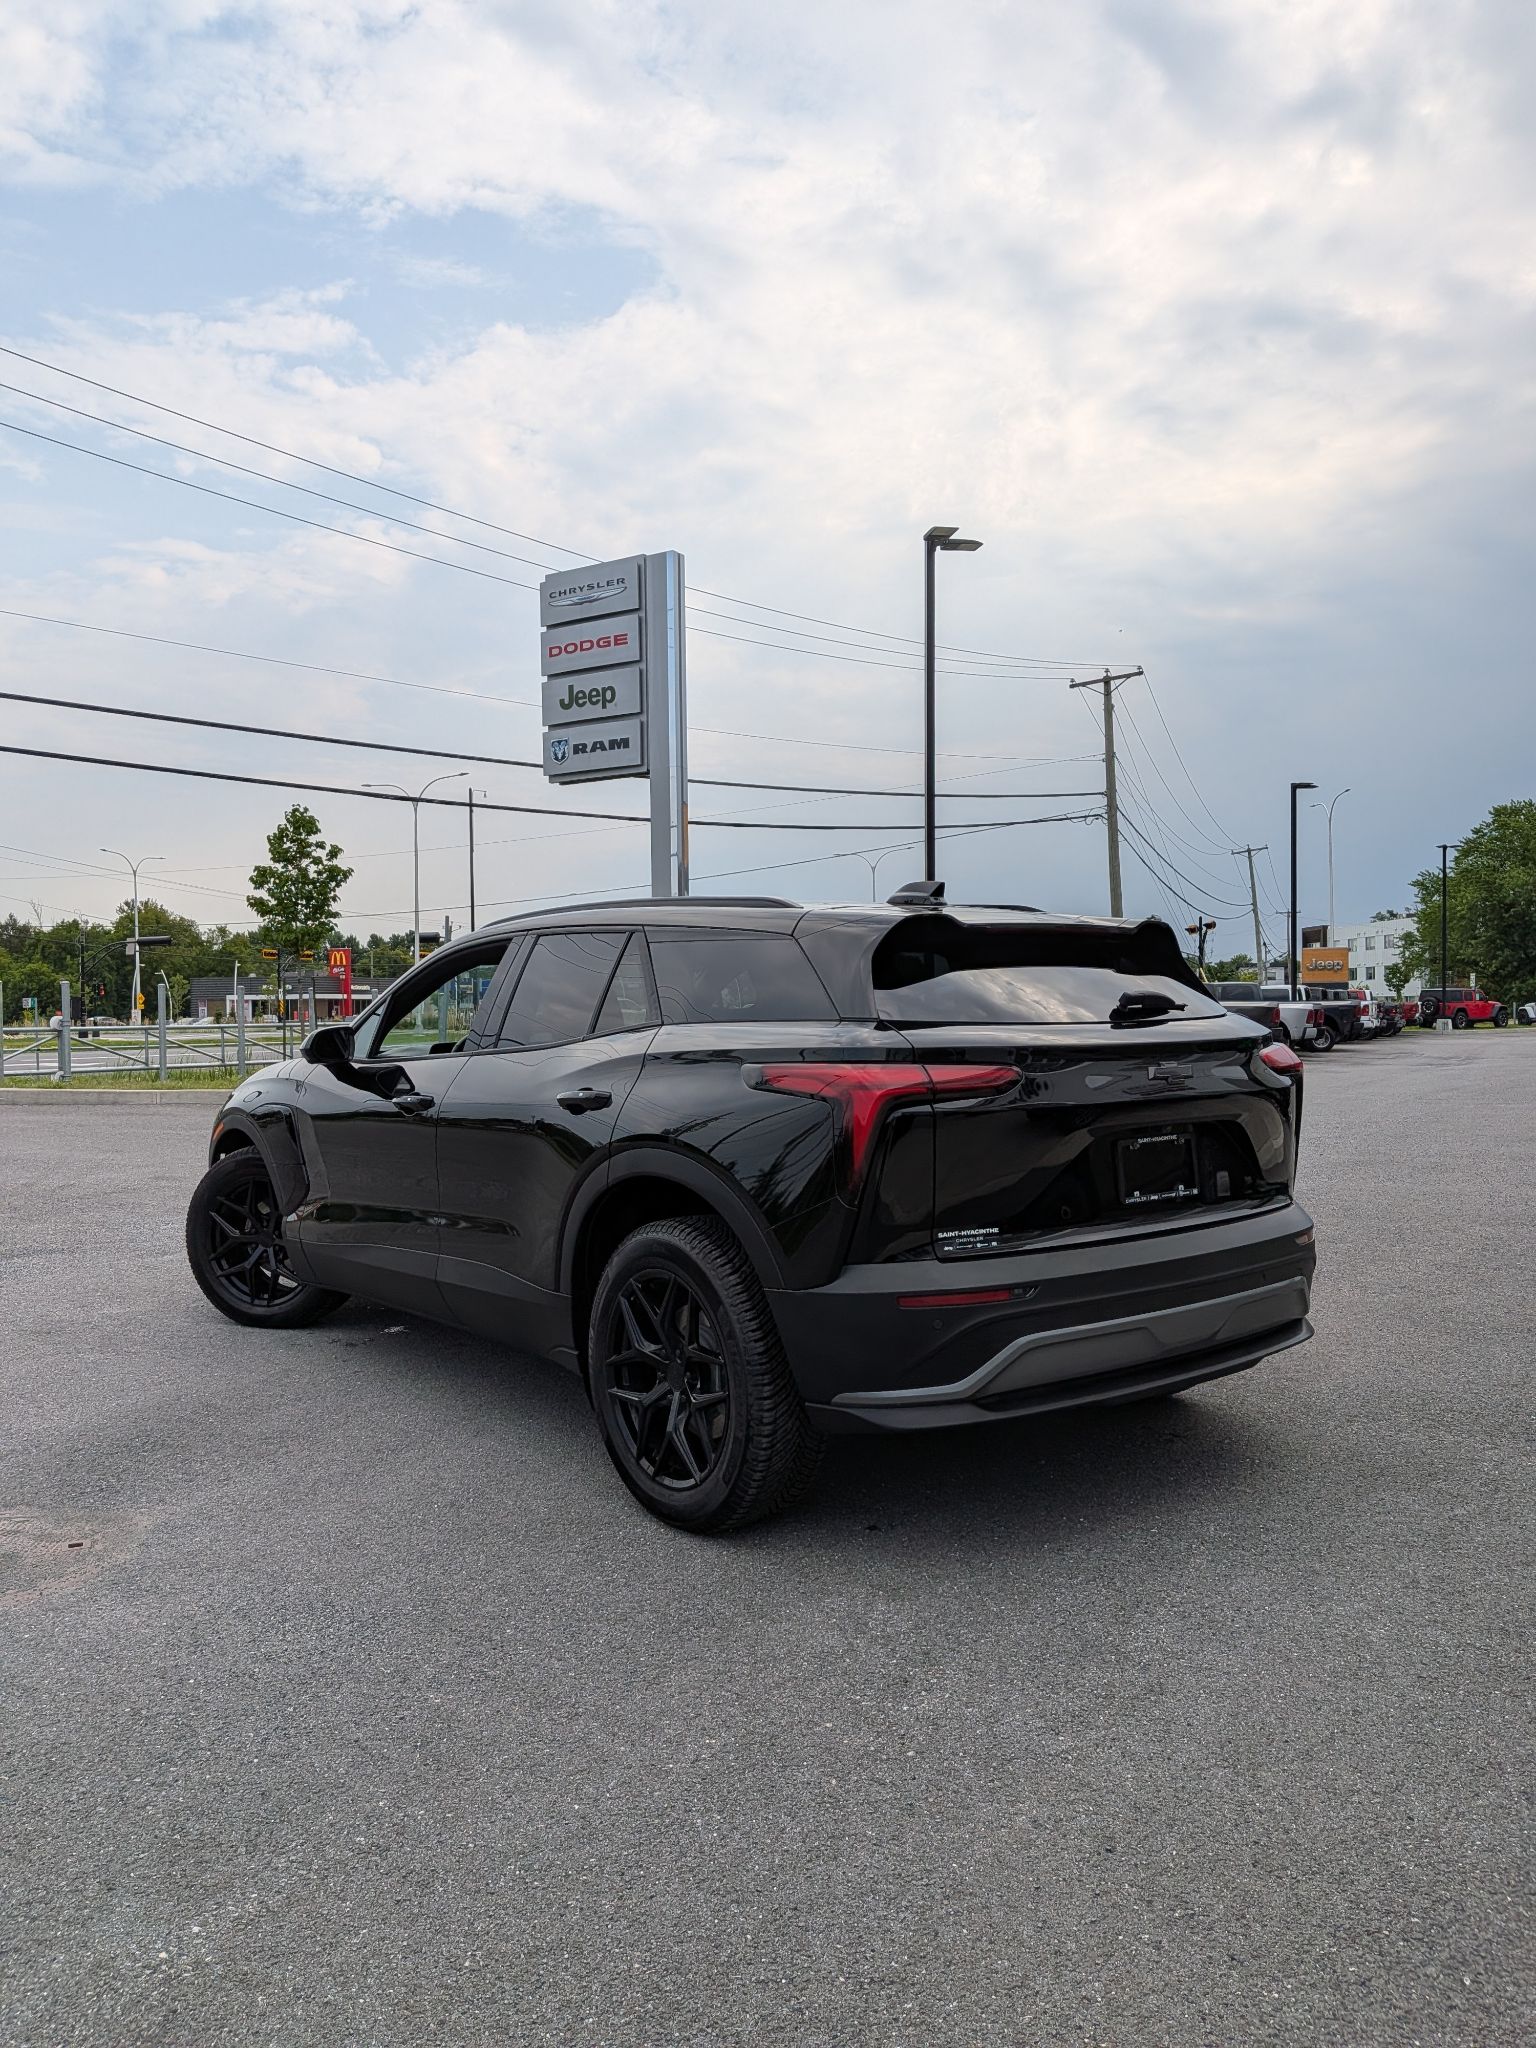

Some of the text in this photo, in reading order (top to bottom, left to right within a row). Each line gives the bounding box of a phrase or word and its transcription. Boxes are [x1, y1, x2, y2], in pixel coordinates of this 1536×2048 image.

[549, 578, 626, 599] CHRYSLER
[548, 633, 628, 658] DODGE
[559, 684, 616, 710] Jeep
[573, 737, 630, 755] RAM
[1306, 959, 1343, 971] Jeep
[938, 1228, 999, 1238] SAINT-HYACINTHE
